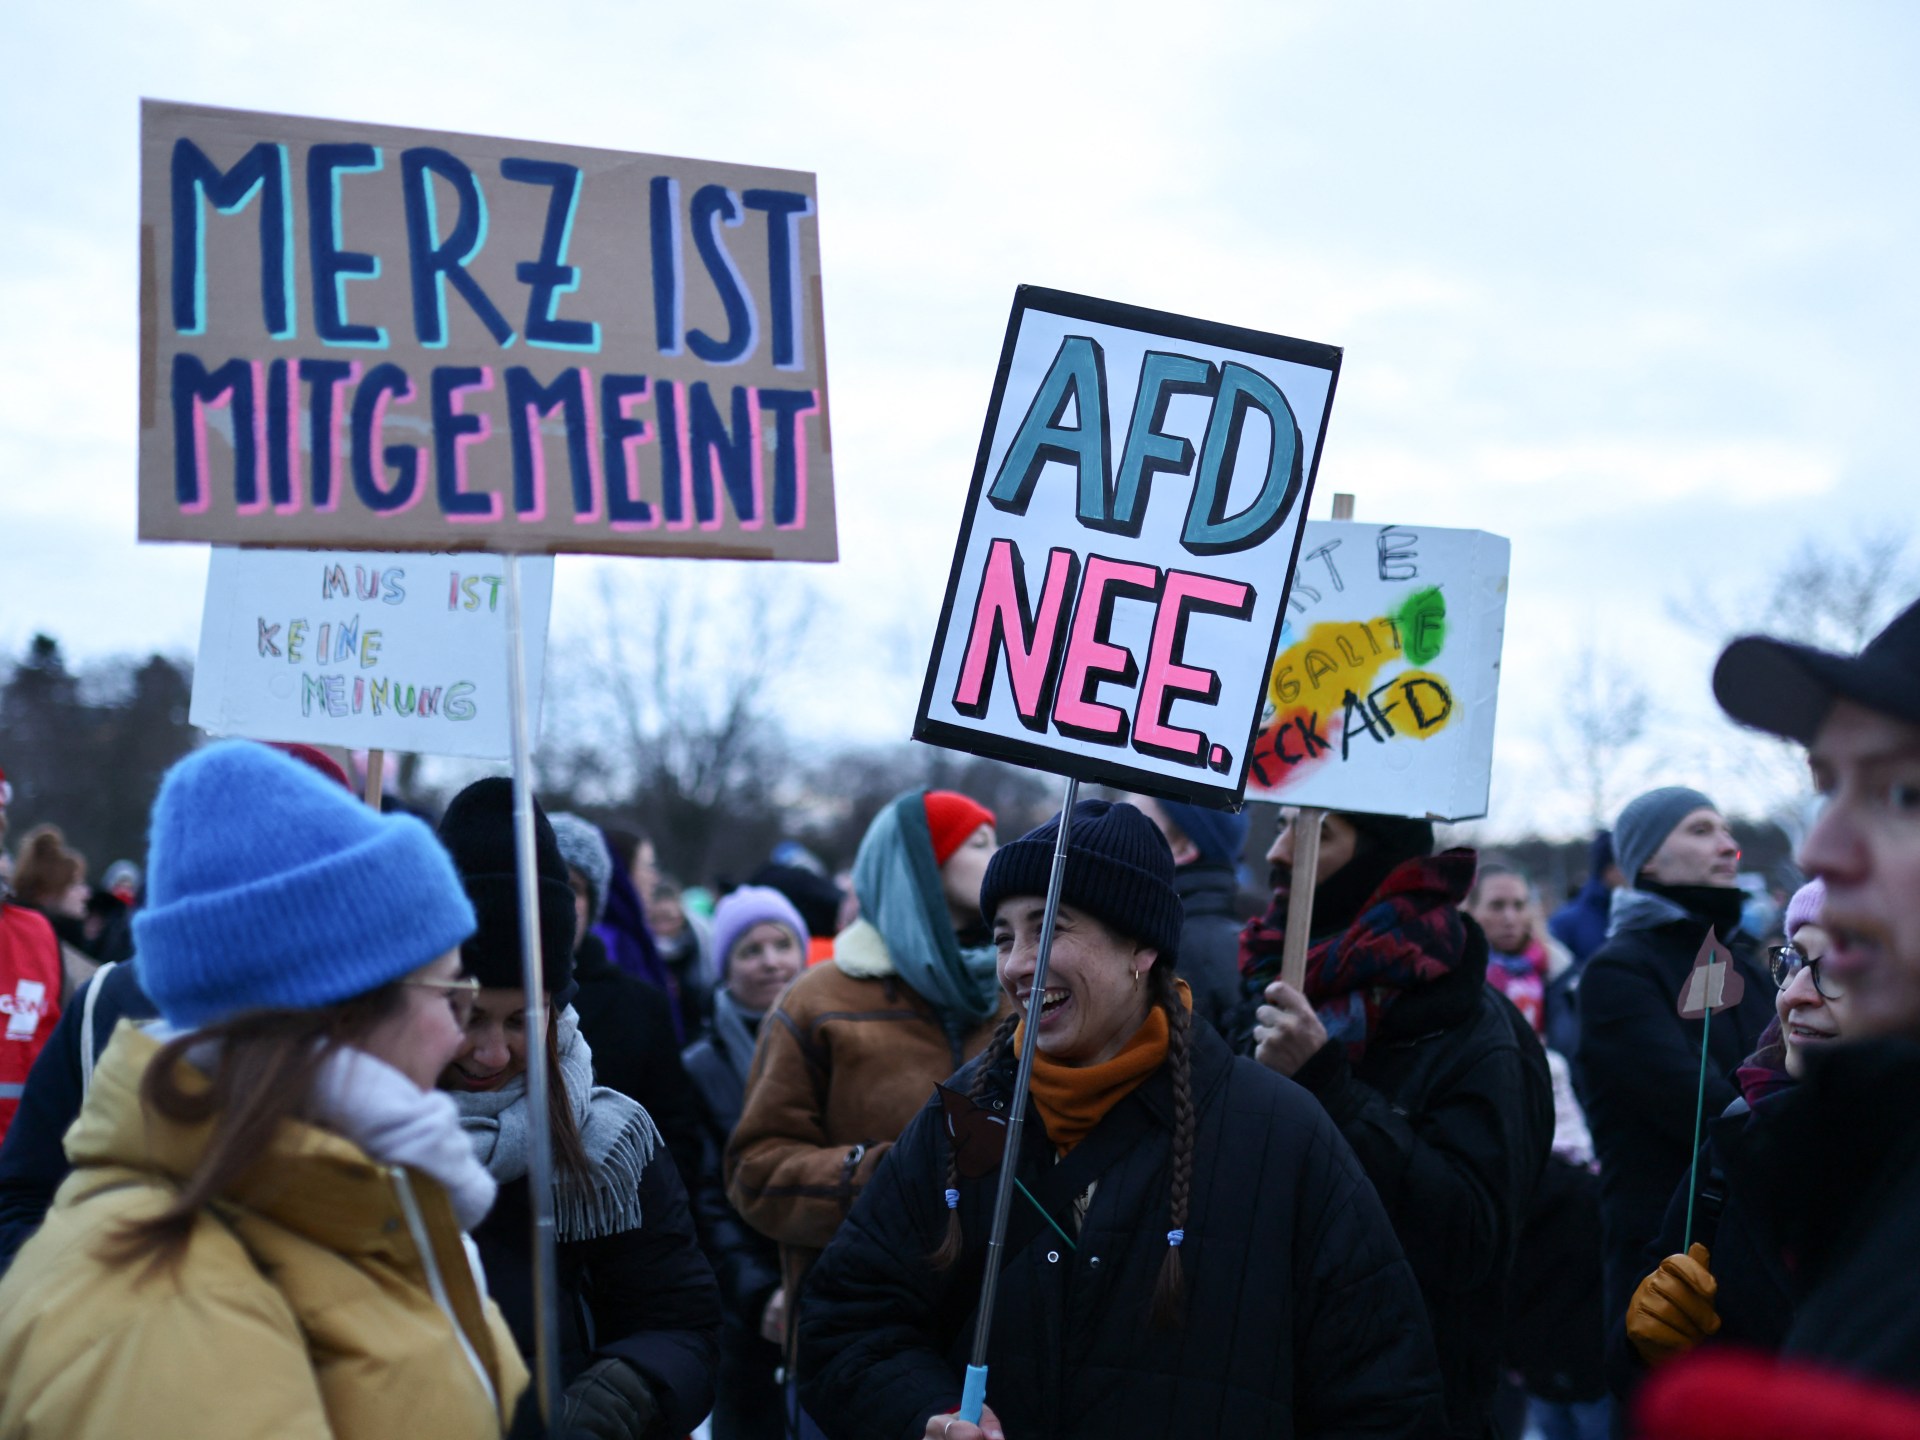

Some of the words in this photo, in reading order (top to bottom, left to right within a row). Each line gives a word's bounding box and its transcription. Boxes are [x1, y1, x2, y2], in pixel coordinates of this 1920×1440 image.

[171, 137, 600, 353] MERZ
[649, 175, 815, 372] IST
[171, 352, 821, 531] MITGEMEINT
[986, 335, 1304, 557] AFD
[257, 613, 383, 669] KEINE
[322, 563, 406, 606] MUS
[447, 571, 506, 612] IST
[952, 538, 1258, 776] NEE.
[1262, 583, 1446, 724] GALITÉ
[301, 671, 477, 722] MEINUNG
[1341, 678, 1452, 762] AFD
